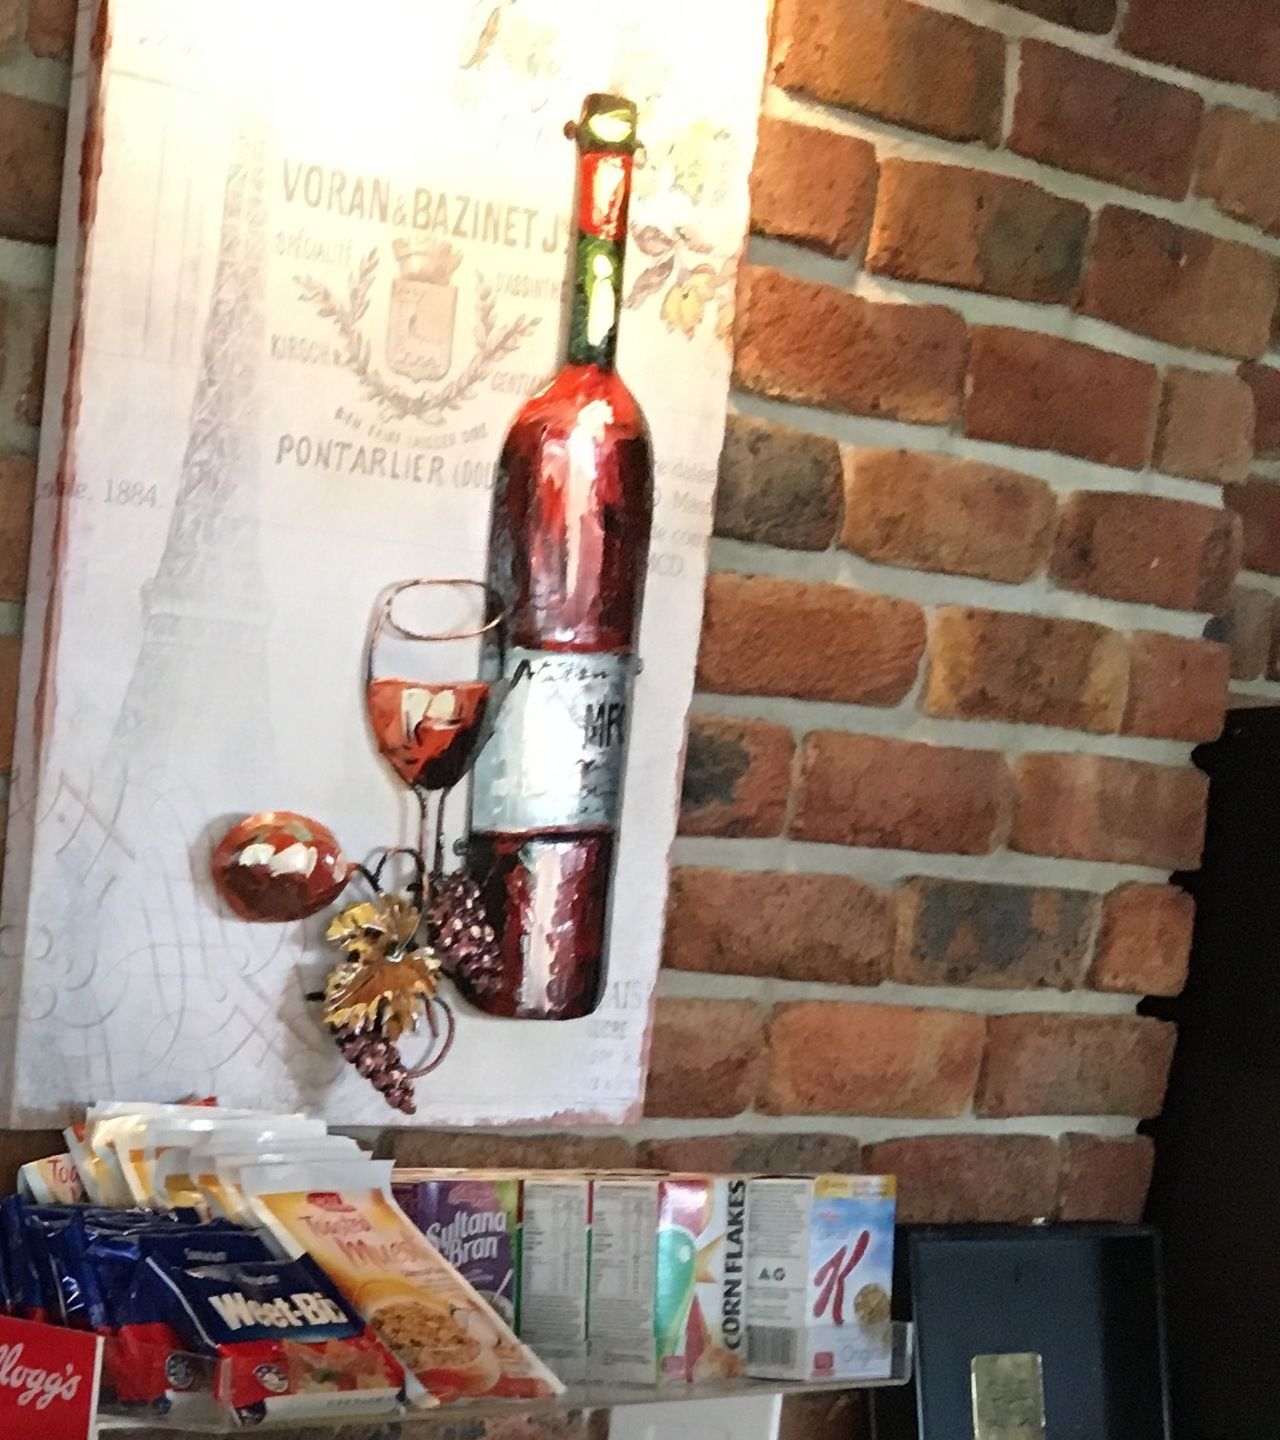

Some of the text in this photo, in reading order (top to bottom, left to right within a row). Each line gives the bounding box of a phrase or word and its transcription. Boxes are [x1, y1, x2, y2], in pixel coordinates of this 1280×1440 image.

[542, 213, 571, 255] J
[274, 432, 444, 485] PONTARLIER
[426, 1210, 507, 1250] Sultana
[448, 1236, 499, 1269] Bran
[721, 1178, 748, 1350] CORN FLAKES
[813, 1230, 871, 1327] K
